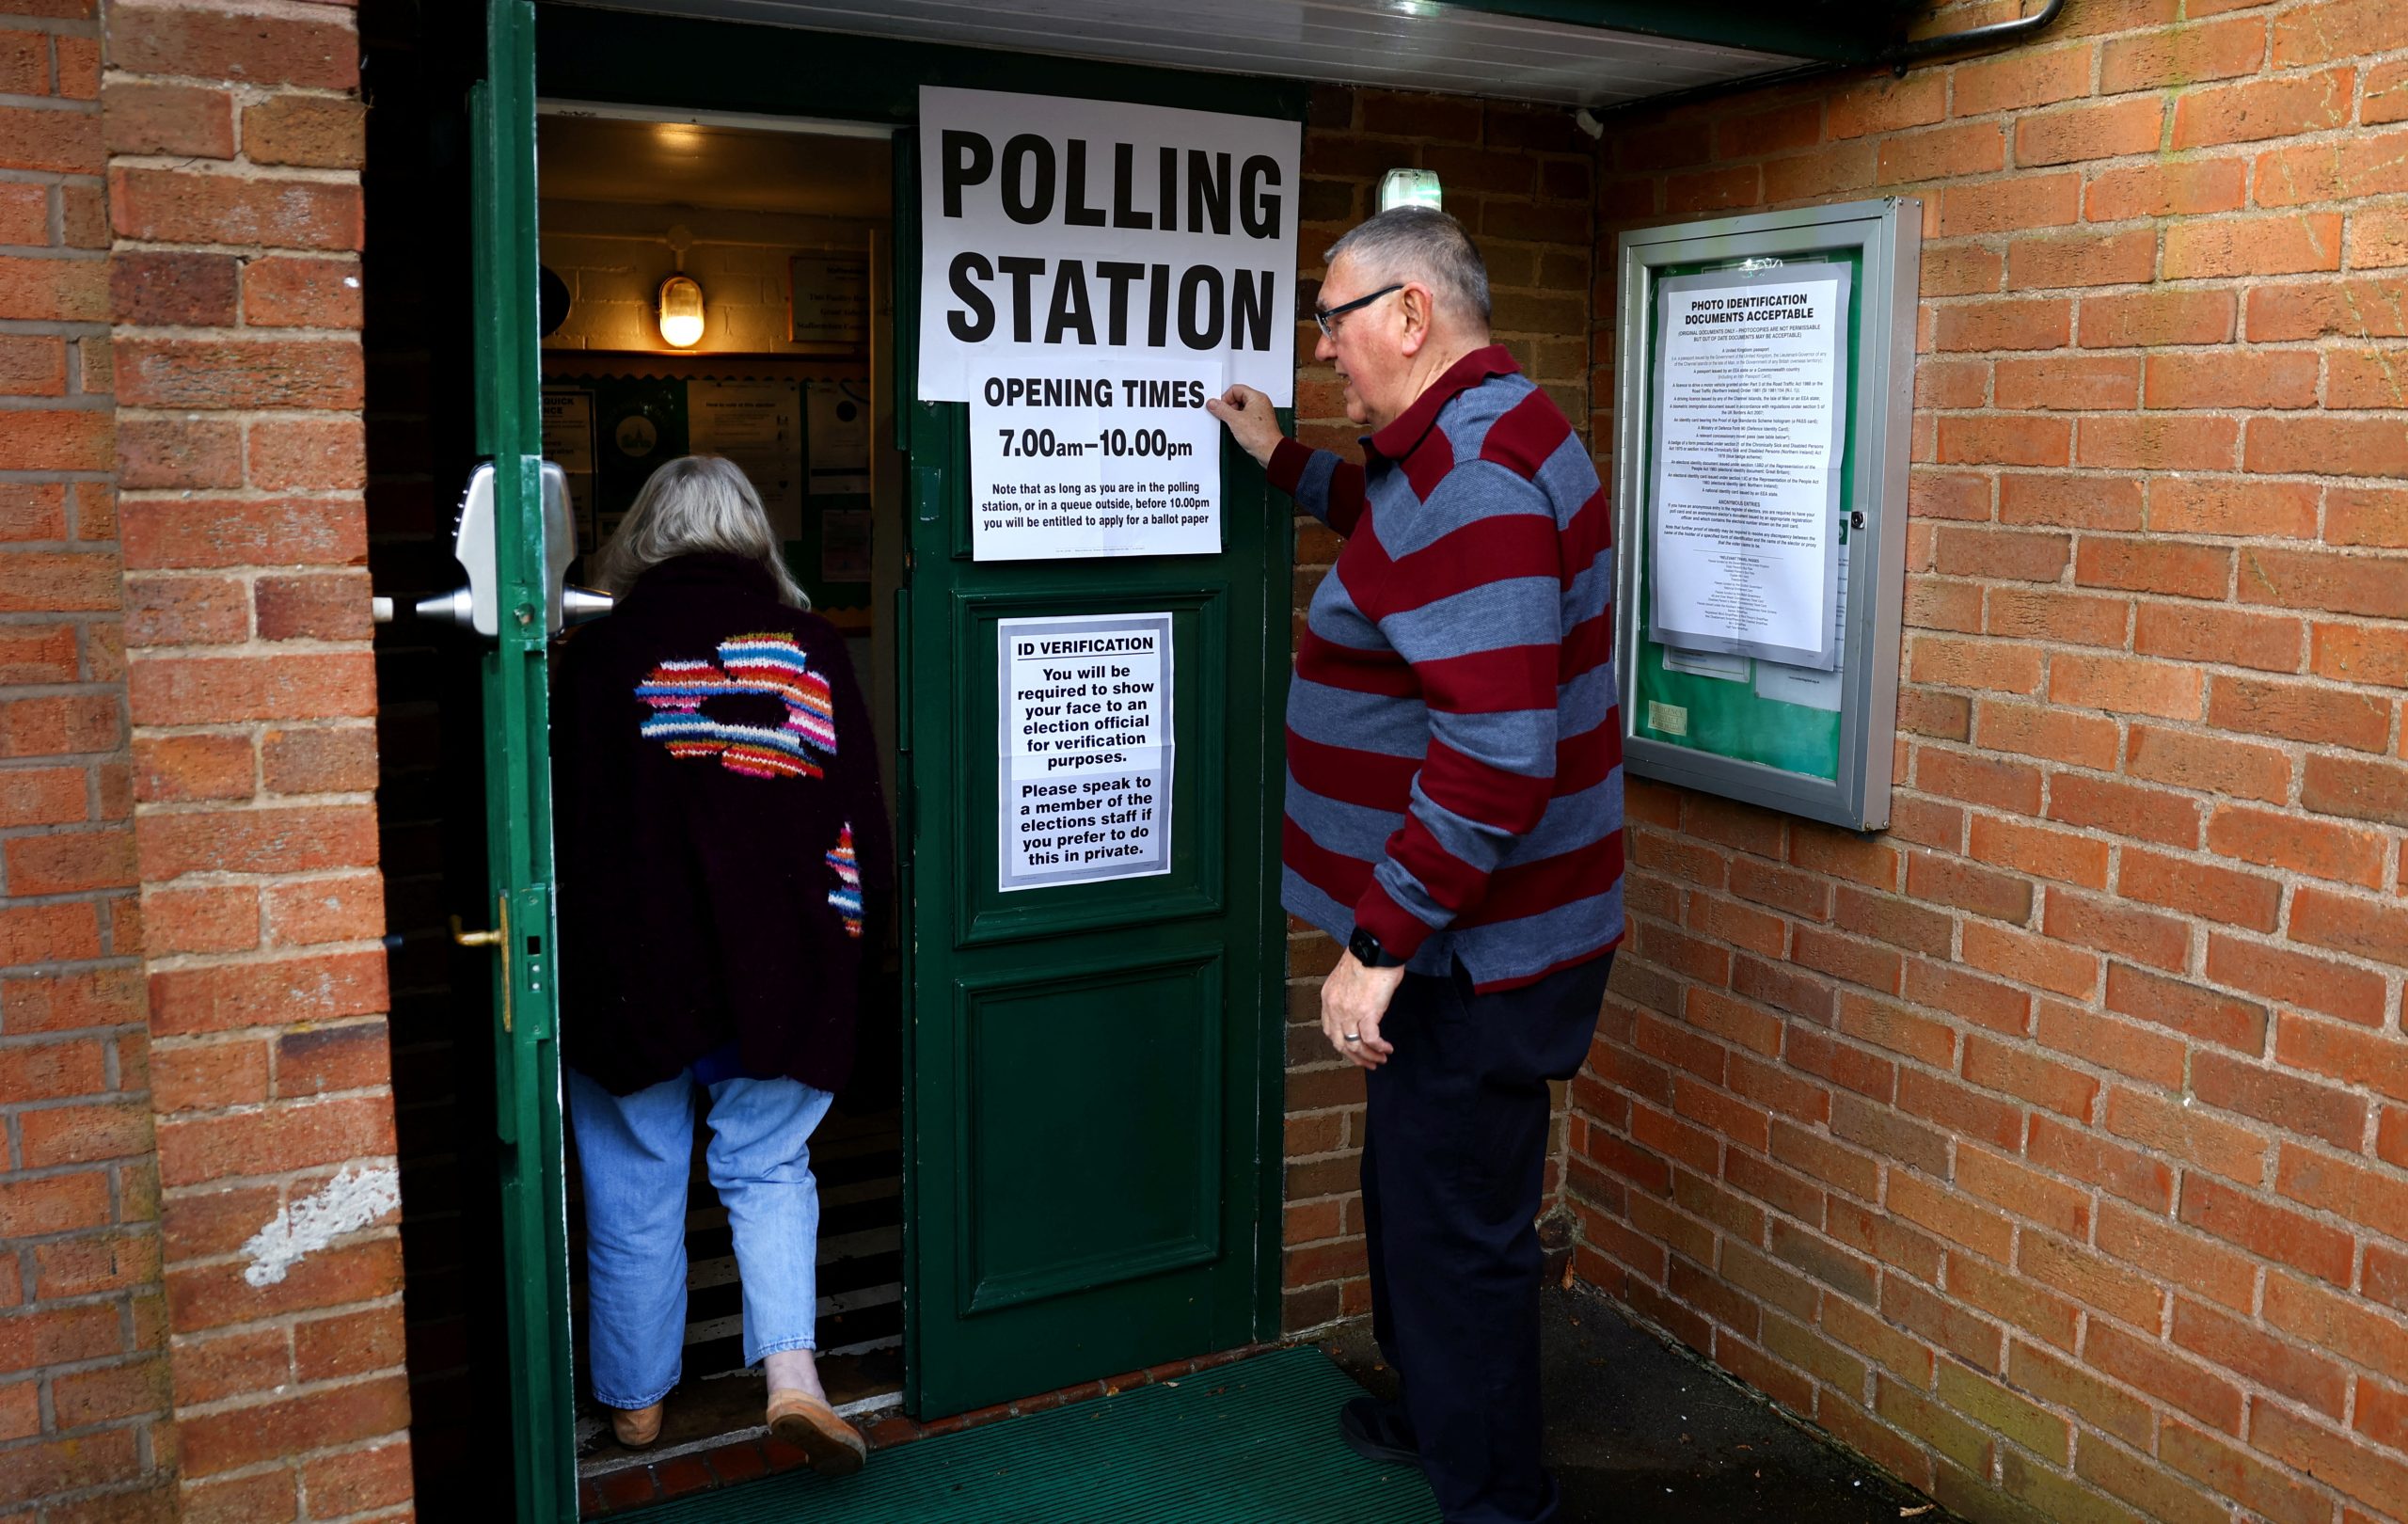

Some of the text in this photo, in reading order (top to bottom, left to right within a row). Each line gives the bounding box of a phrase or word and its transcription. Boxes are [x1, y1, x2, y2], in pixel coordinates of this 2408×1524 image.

[943, 129, 1281, 240] POLLING
[947, 252, 1275, 352] STATION
[1692, 294, 1807, 311] PHOTO IDENTIFICATION
[1686, 308, 1814, 325] DOCUMENTS ACCEPTABLE
[544, 397, 575, 405] QUICK
[985, 377, 1205, 408] OPENING TIMES
[993, 484, 1017, 495] Note
[1020, 484, 1041, 494] that
[1044, 485, 1056, 494] as
[1059, 484, 1081, 496] long
[1100, 484, 1116, 496] you
[1119, 484, 1134, 493] are
[1137, 482, 1146, 492] in
[1149, 482, 1164, 492] the
[1168, 482, 1199, 495] polling
[982, 500, 1022, 513] station,
[1025, 502, 1036, 511] or
[1038, 500, 1048, 510] in
[1061, 501, 1092, 513] queue
[1096, 499, 1133, 511] outside,
[1136, 499, 1166, 509] before
[1170, 498, 1210, 510] 10.00pm
[984, 514, 1209, 532] you will be entitled to apply for a ballot paper
[1019, 637, 1153, 656] ID VERIFICATION
[1043, 665, 1130, 681] You will be
[1019, 682, 1154, 702] required to show
[1025, 700, 1147, 721] your face to an
[1023, 715, 1149, 735] election official
[1027, 733, 1146, 752] for verification
[1048, 754, 1127, 770] purposes.
[1022, 777, 1151, 798] Please speak to
[1021, 793, 1152, 816] a member of the
[1022, 808, 1152, 833] elections staff if
[1023, 826, 1149, 852] you prefer to do
[1029, 845, 1143, 865] this in private.
